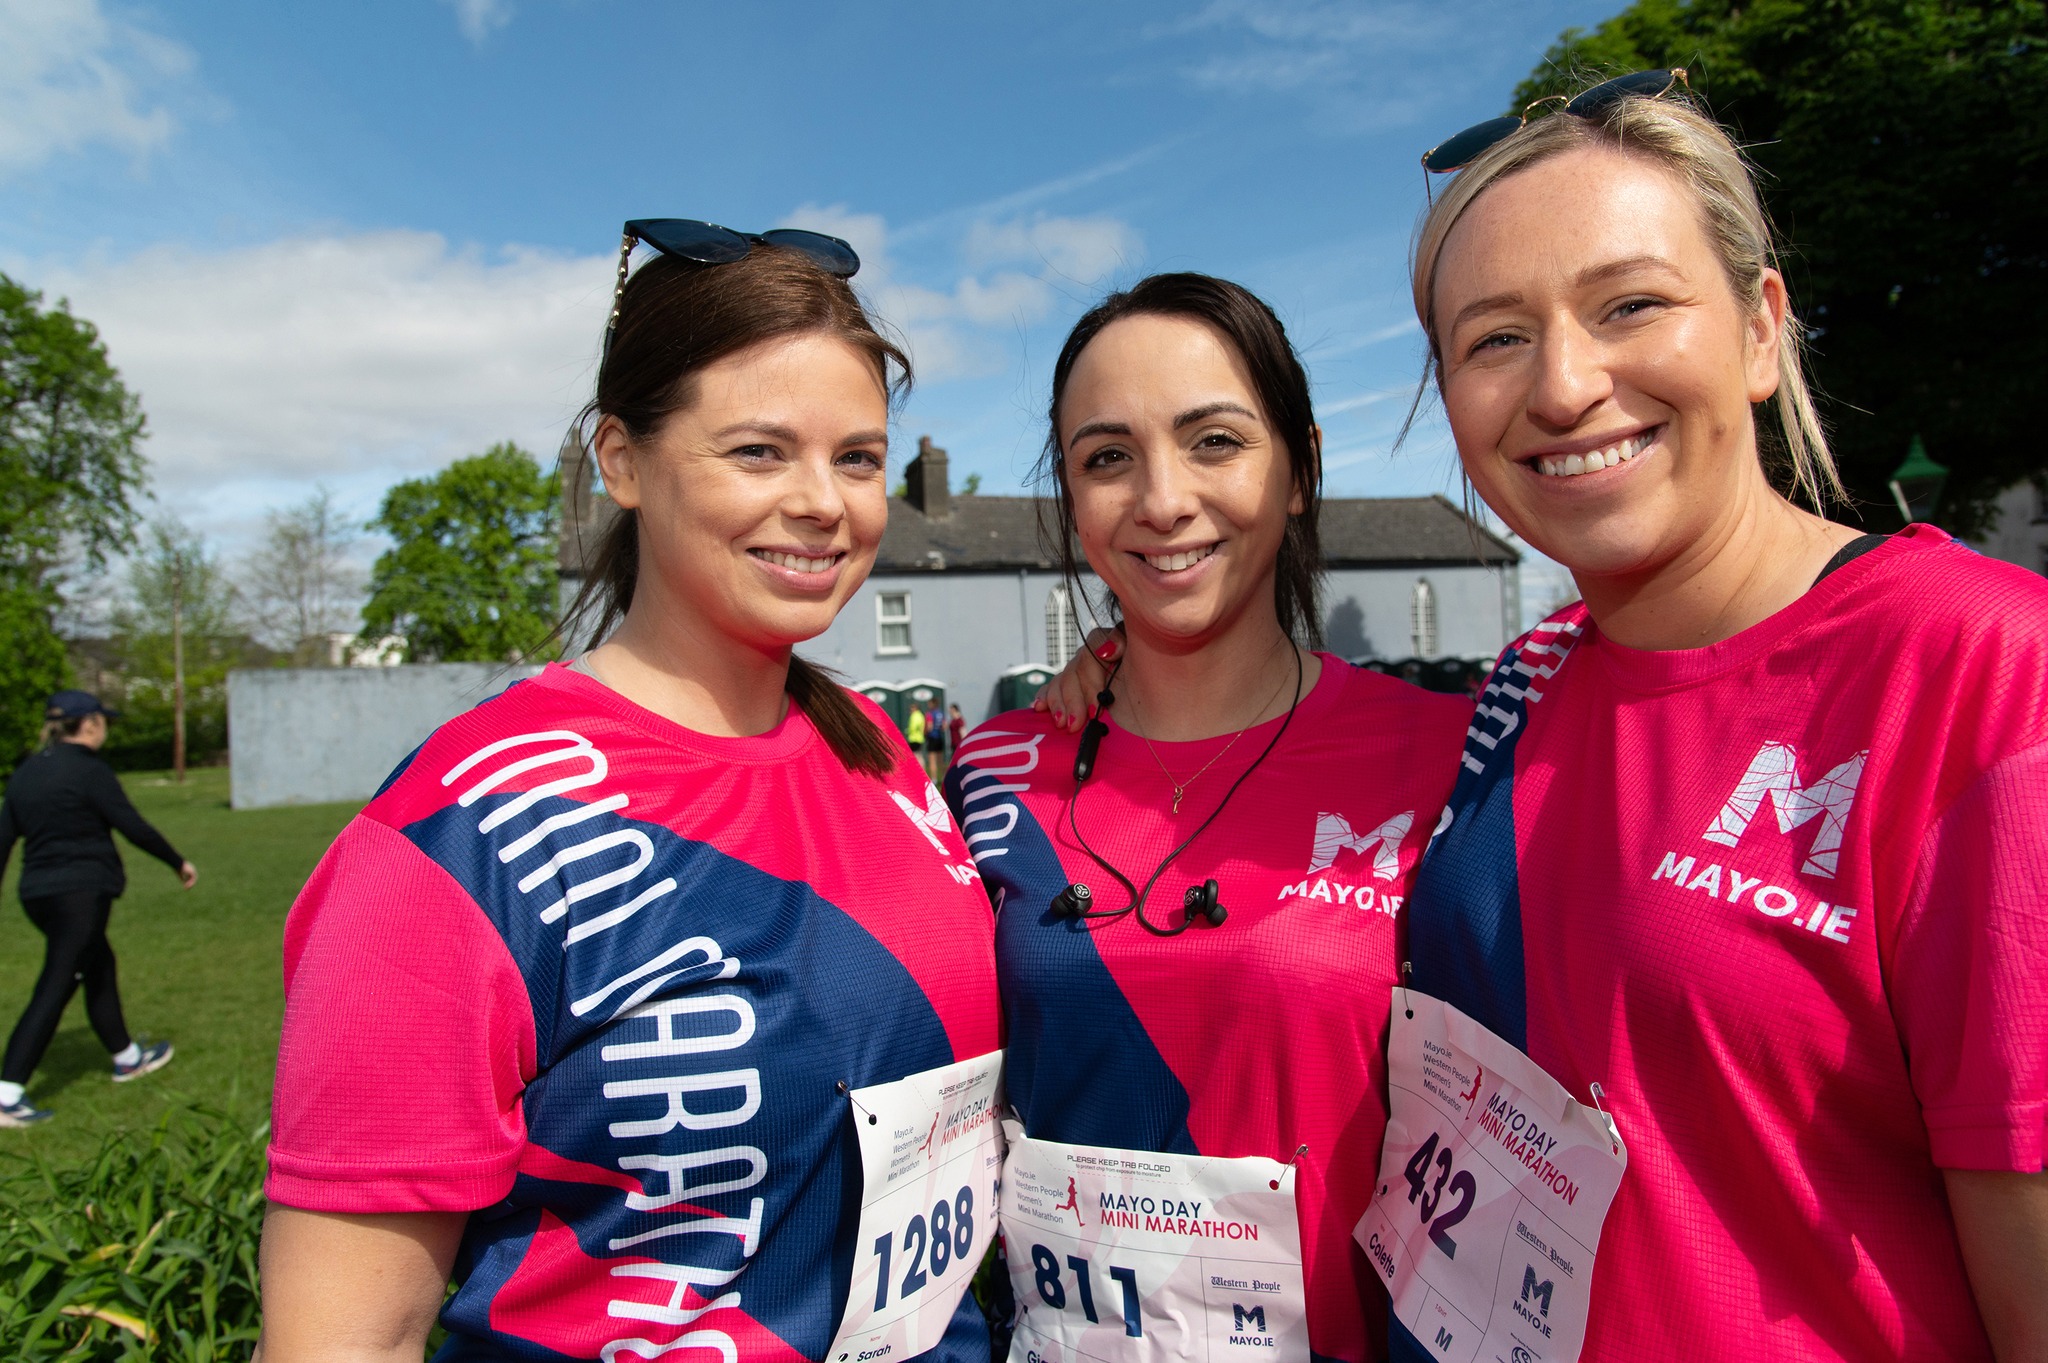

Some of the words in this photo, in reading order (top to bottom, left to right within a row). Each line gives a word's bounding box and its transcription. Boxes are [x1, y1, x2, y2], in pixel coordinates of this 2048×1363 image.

[441, 729, 678, 952] MINI
[1651, 850, 1858, 945] MAYO.IE
[1423, 1040, 1453, 1059] Mayo.ie
[1423, 1053, 1452, 1074] Western
[1452, 1067, 1471, 1087] People
[1423, 1066, 1451, 1088] Women's
[945, 1104, 972, 1131] MAYO
[971, 1095, 990, 1116] DAY
[1423, 1079, 1438, 1094] Mini
[1438, 1088, 1462, 1113] Marathon
[893, 1125, 915, 1141] Mayo.ie
[940, 1122, 962, 1147] MINI
[961, 1101, 1005, 1137] MARATHON
[1486, 1091, 1527, 1132] MAYO
[1523, 1123, 1558, 1156] DAY
[886, 1171, 898, 1183] Mini
[898, 1160, 920, 1177] Marathon
[1014, 1166, 1036, 1181] Mayo.ie
[1066, 1154, 1097, 1165] PLEASE
[1098, 1158, 1119, 1167] KEEP
[1120, 1160, 1137, 1169] TAB
[1138, 1163, 1171, 1173] FOLDED
[1477, 1108, 1506, 1142] MINI
[1502, 1130, 1580, 1206] MARATHON
[1015, 1179, 1039, 1194] Western
[1040, 1185, 1064, 1199] People
[1016, 1191, 1043, 1207] Women's
[1099, 1192, 1155, 1215] MAYO
[1162, 1199, 1202, 1219] DAY
[1403, 1131, 1477, 1261] 432
[1017, 1203, 1032, 1216] Mini
[1032, 1208, 1064, 1224] Marathon
[1100, 1208, 1140, 1231] MINI
[1145, 1215, 1259, 1242] MARATHON
[873, 1185, 974, 1313] 1288
[1369, 1232, 1396, 1279] Colette
[1516, 1220, 1548, 1253] Western
[1549, 1246, 1574, 1275] People
[1031, 1243, 1143, 1338] 811
[1210, 1275, 1249, 1289] Western
[1251, 1280, 1282, 1293] People
[1512, 1300, 1552, 1339] MAYO.IE
[857, 1344, 892, 1362] Sarah
[1229, 1335, 1275, 1347] MAYO.IE
[1434, 1325, 1453, 1353] M
